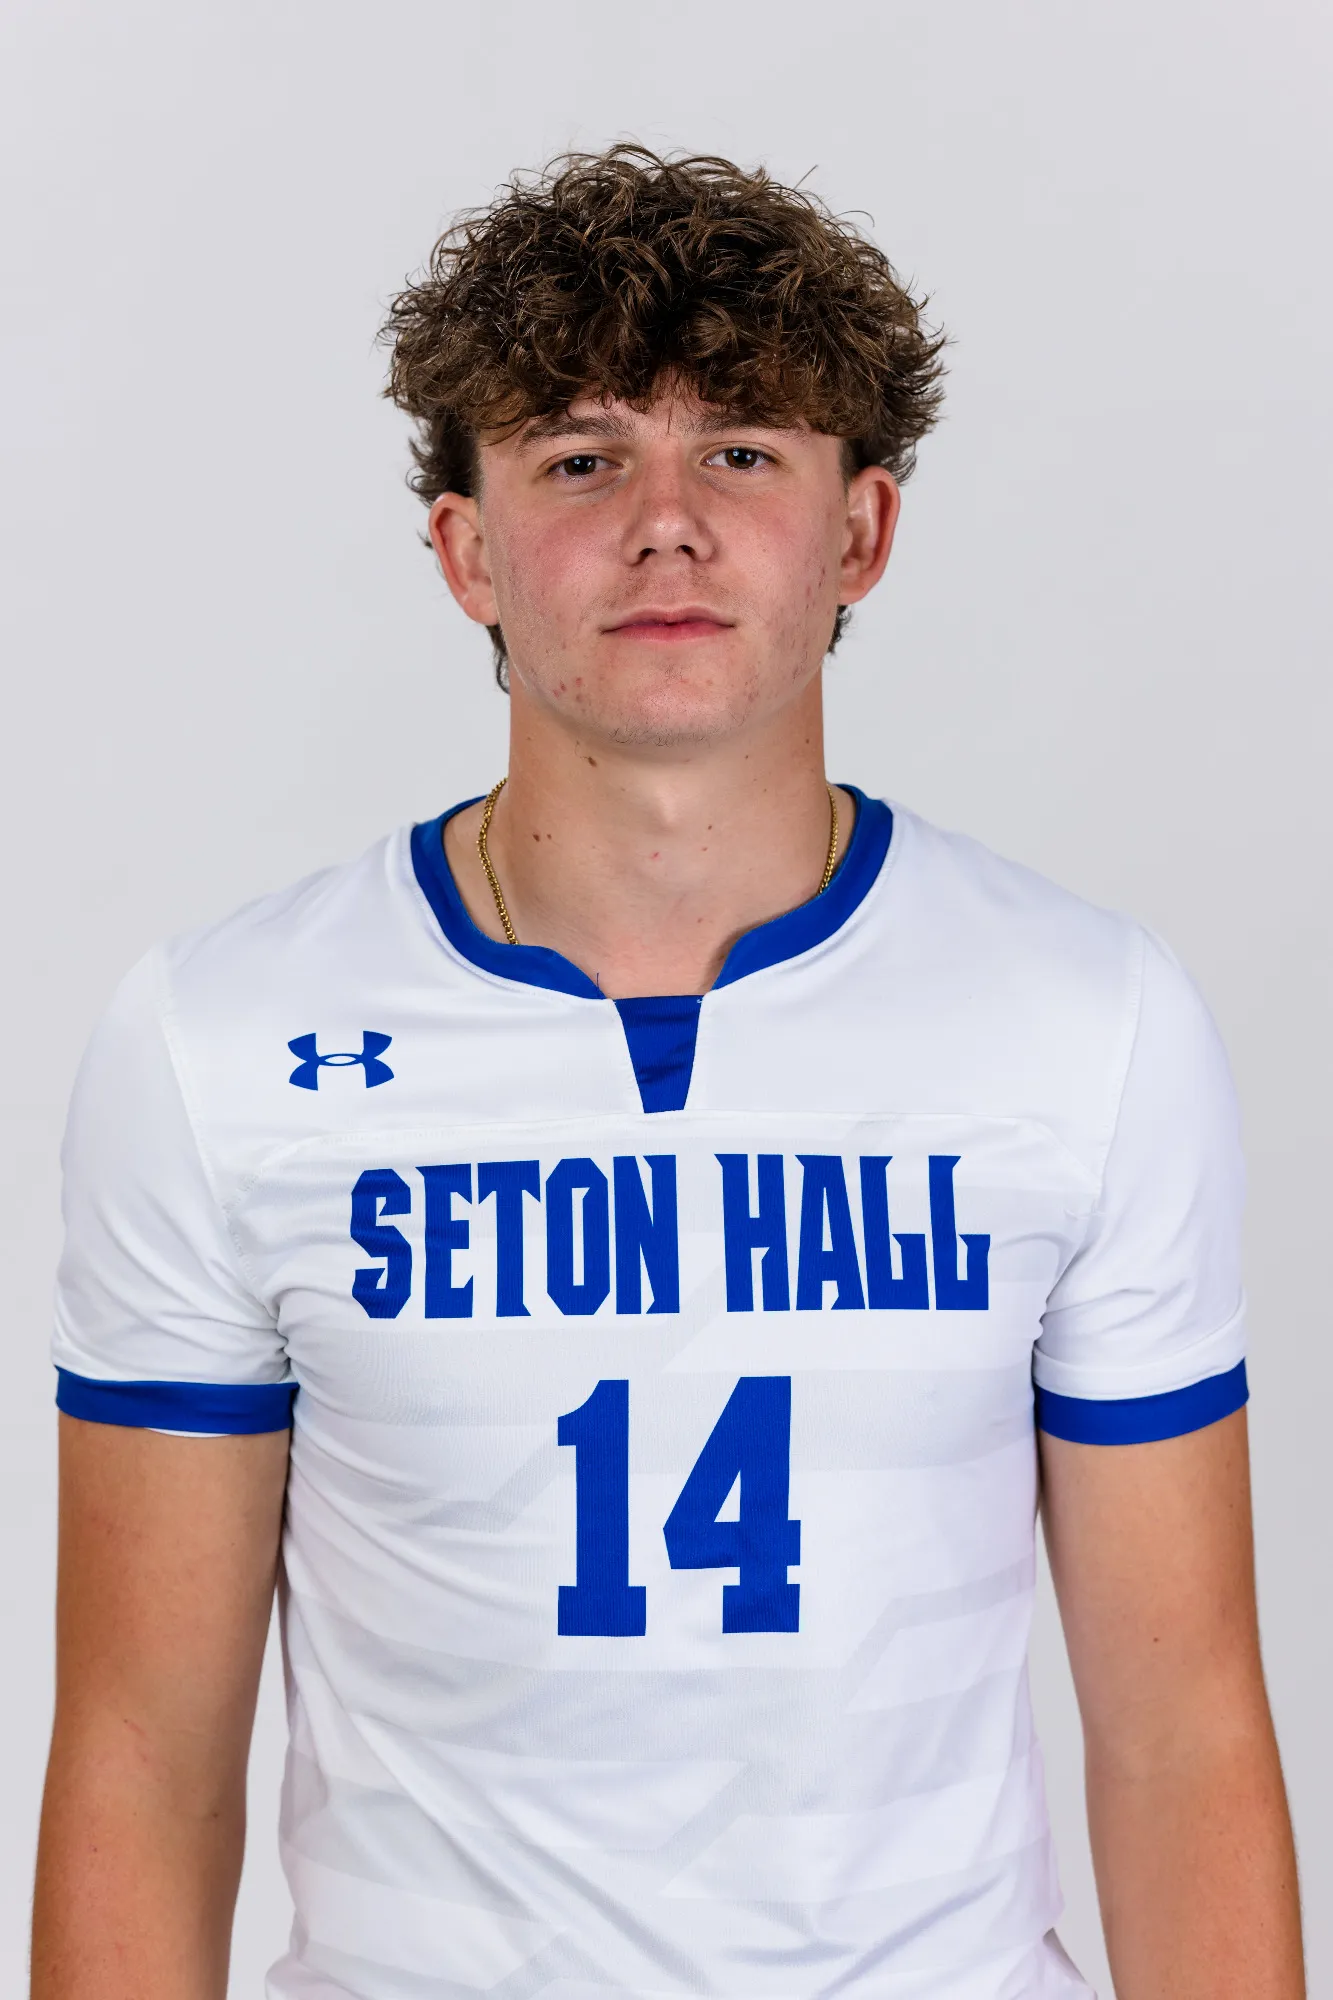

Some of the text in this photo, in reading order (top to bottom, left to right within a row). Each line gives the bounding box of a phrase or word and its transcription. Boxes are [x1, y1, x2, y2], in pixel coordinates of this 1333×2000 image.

[350, 1153, 991, 1319] SETON HALL
[557, 1376, 802, 1637] 14
